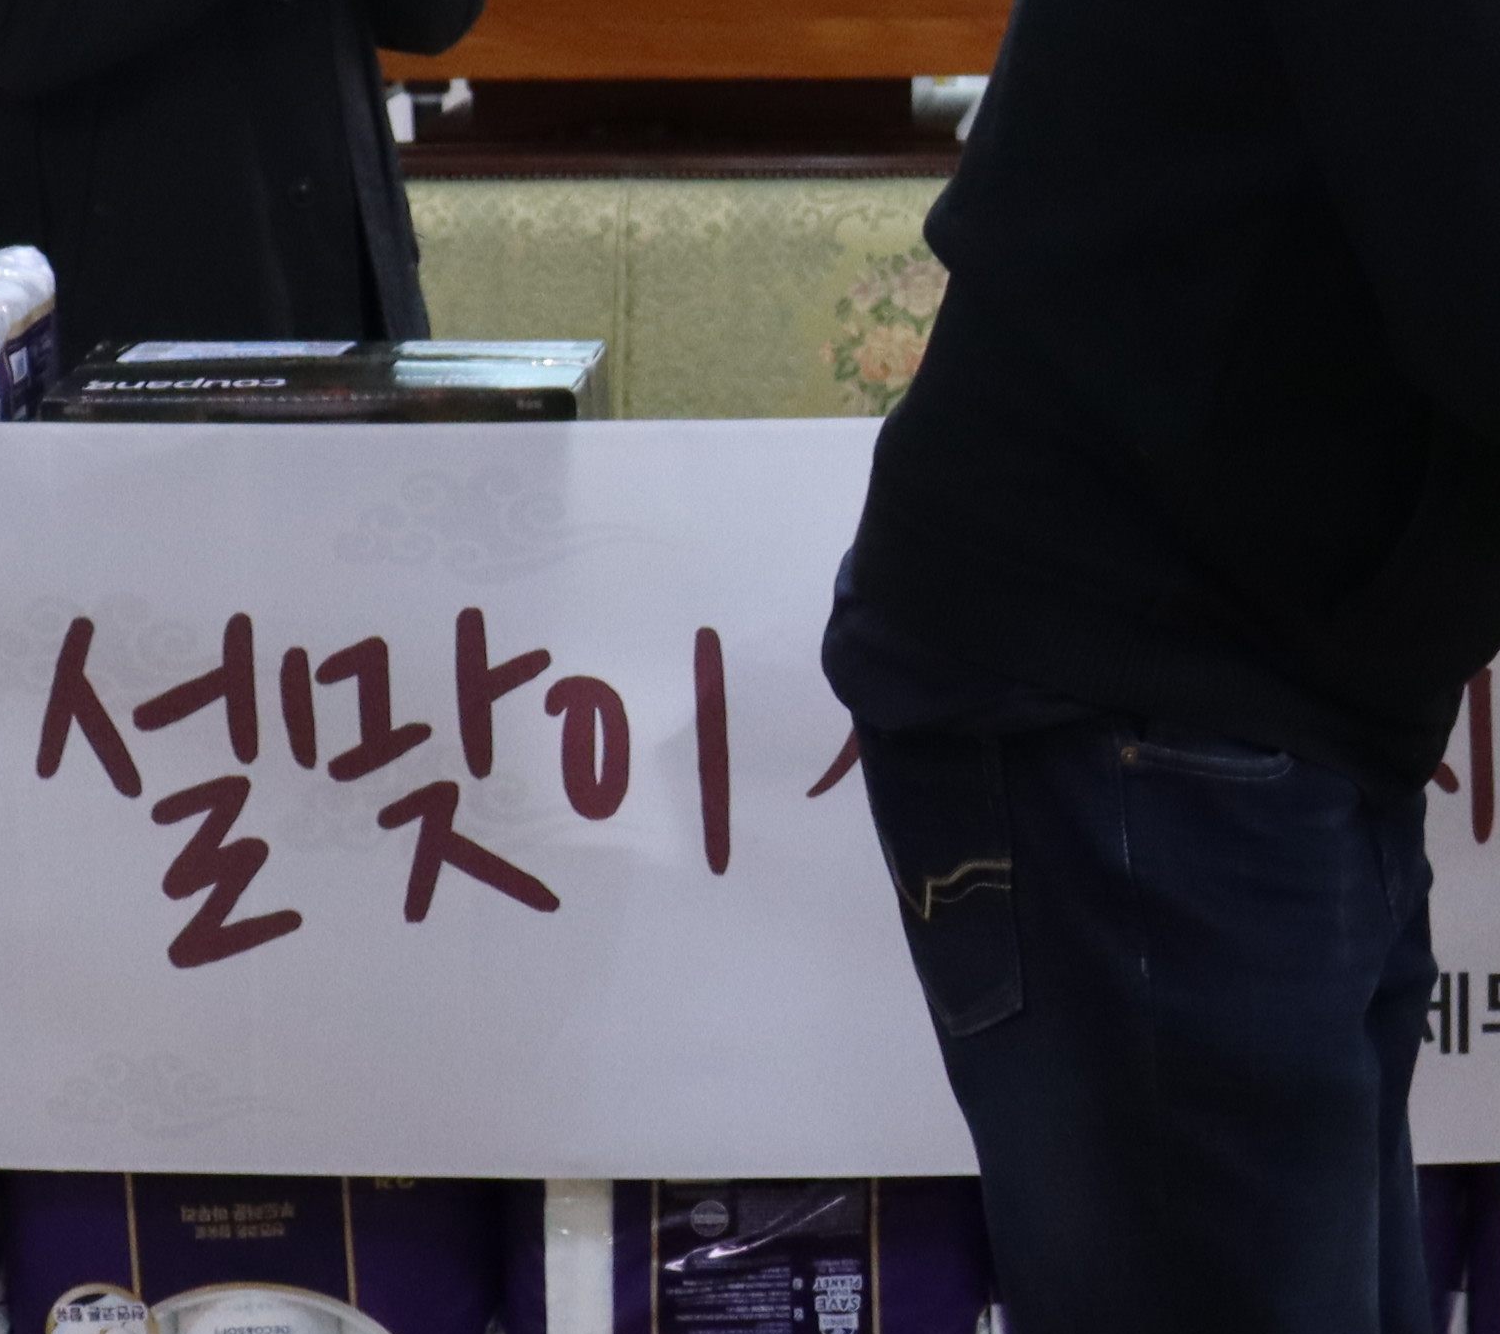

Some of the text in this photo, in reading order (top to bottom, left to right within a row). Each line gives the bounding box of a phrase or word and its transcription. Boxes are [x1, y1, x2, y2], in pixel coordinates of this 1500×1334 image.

[81, 377, 287, 391] coupang
[36, 606, 731, 969] 설맞이
[816, 1297, 859, 1311] SAVE
[54, 1304, 146, 1324] 천연코튼 함유
